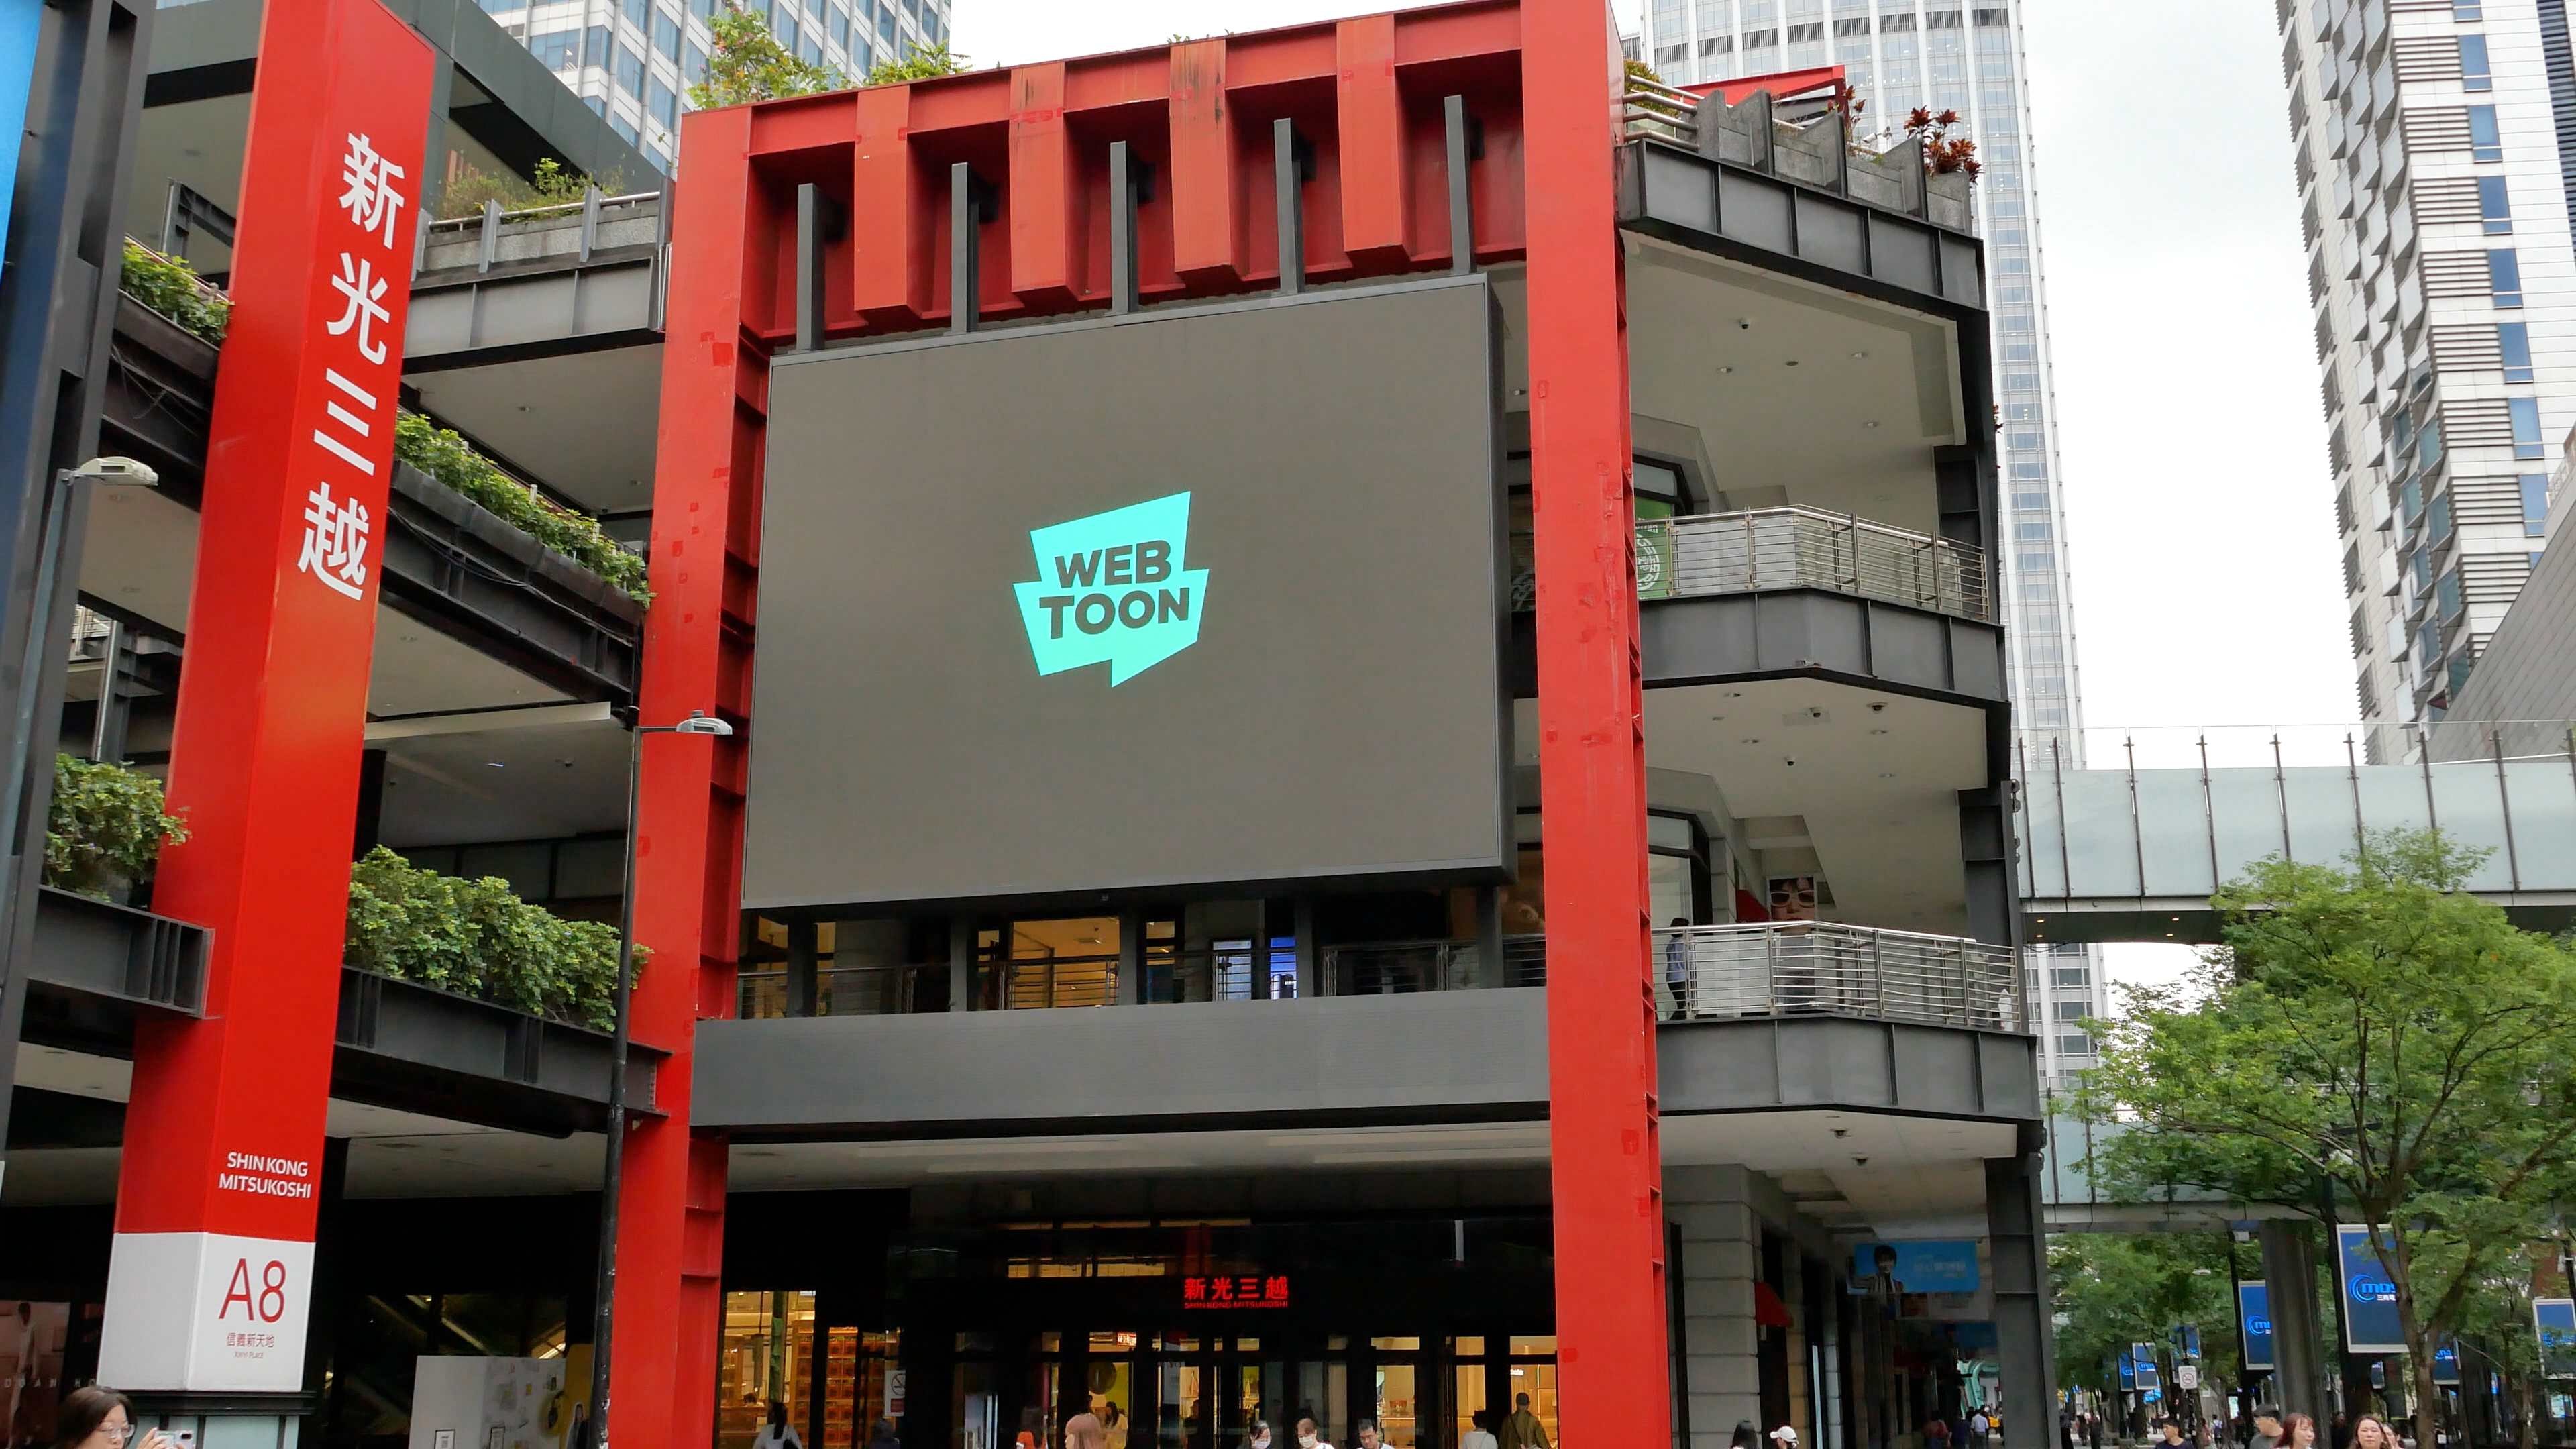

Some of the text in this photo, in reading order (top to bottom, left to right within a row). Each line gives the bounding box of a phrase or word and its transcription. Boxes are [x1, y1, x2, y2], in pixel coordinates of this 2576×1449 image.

[298, 133, 405, 601] 新光三越
[1055, 540, 1171, 588] WEB
[1039, 587, 1190, 639] TOON
[227, 1151, 308, 1177] SHIN KONG
[218, 1173, 311, 1199] MITSUKOSHI
[219, 1258, 286, 1323] A8
[1184, 1276, 1289, 1300] 新光三越
[1234, 1300, 1289, 1308] MITSUKOSHI
[227, 1332, 274, 1348] 信義新天地
